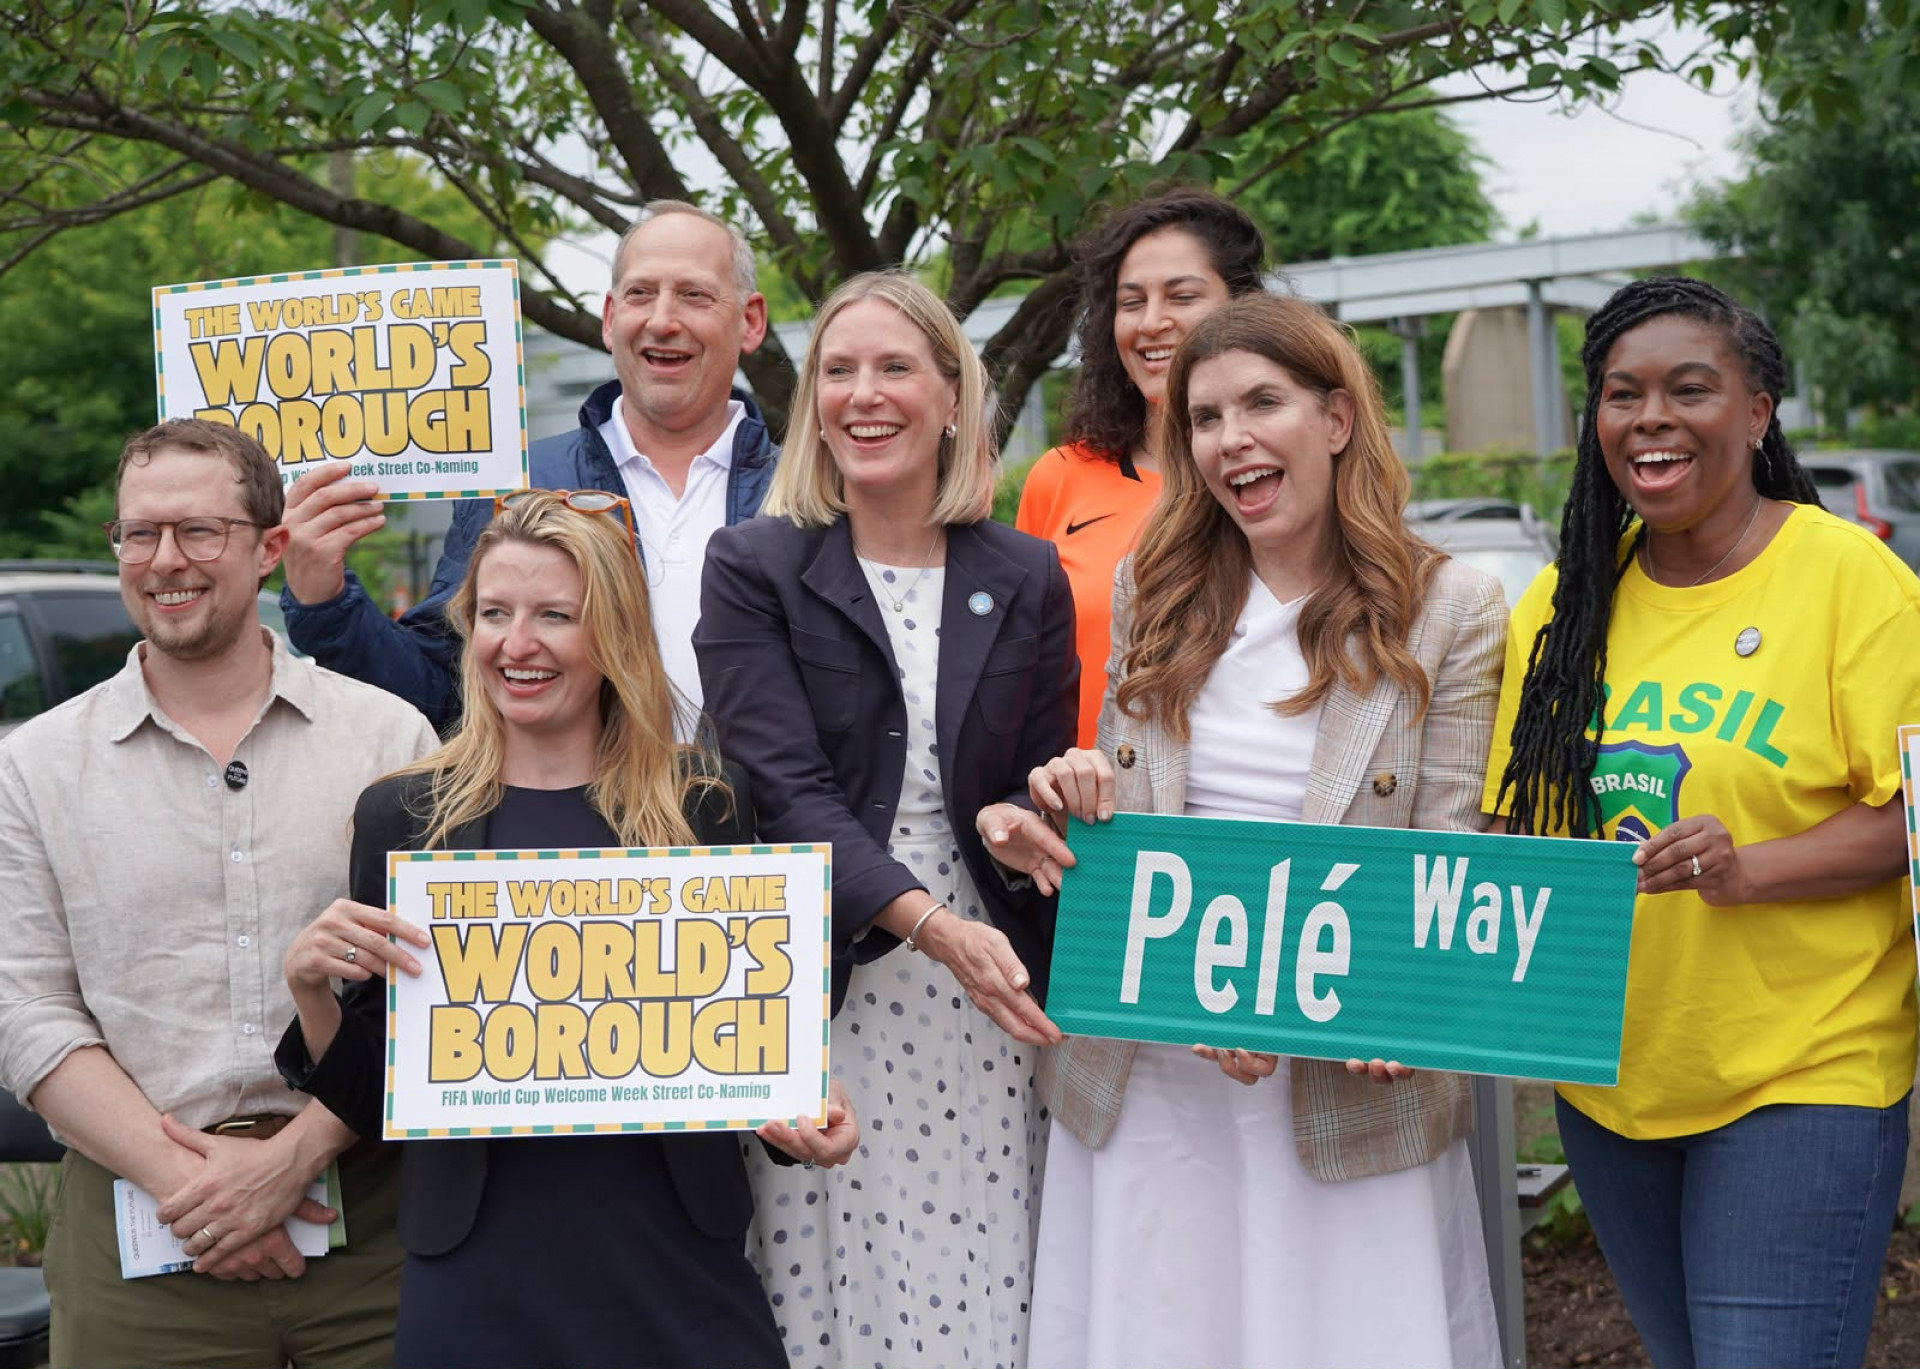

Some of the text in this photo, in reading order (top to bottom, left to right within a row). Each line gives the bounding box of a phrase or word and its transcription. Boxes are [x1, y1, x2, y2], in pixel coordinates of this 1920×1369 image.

[184, 286, 482, 338] THE WORLD'S GAME
[188, 320, 492, 407] WORLD'S
[377, 461, 413, 476] Street
[416, 459, 479, 475] Co-Naming
[1586, 680, 1789, 769] ASIL
[1589, 772, 1666, 798] BRASIL
[426, 874, 787, 919] THE WORLD'S GAME
[430, 915, 793, 1004] WORLD'S
[1119, 850, 1552, 1022] Pelé Way
[428, 996, 790, 1084] BOROUGH
[441, 1082, 771, 1107] FIFA World Cup Welcome Week Street Co-Naming
